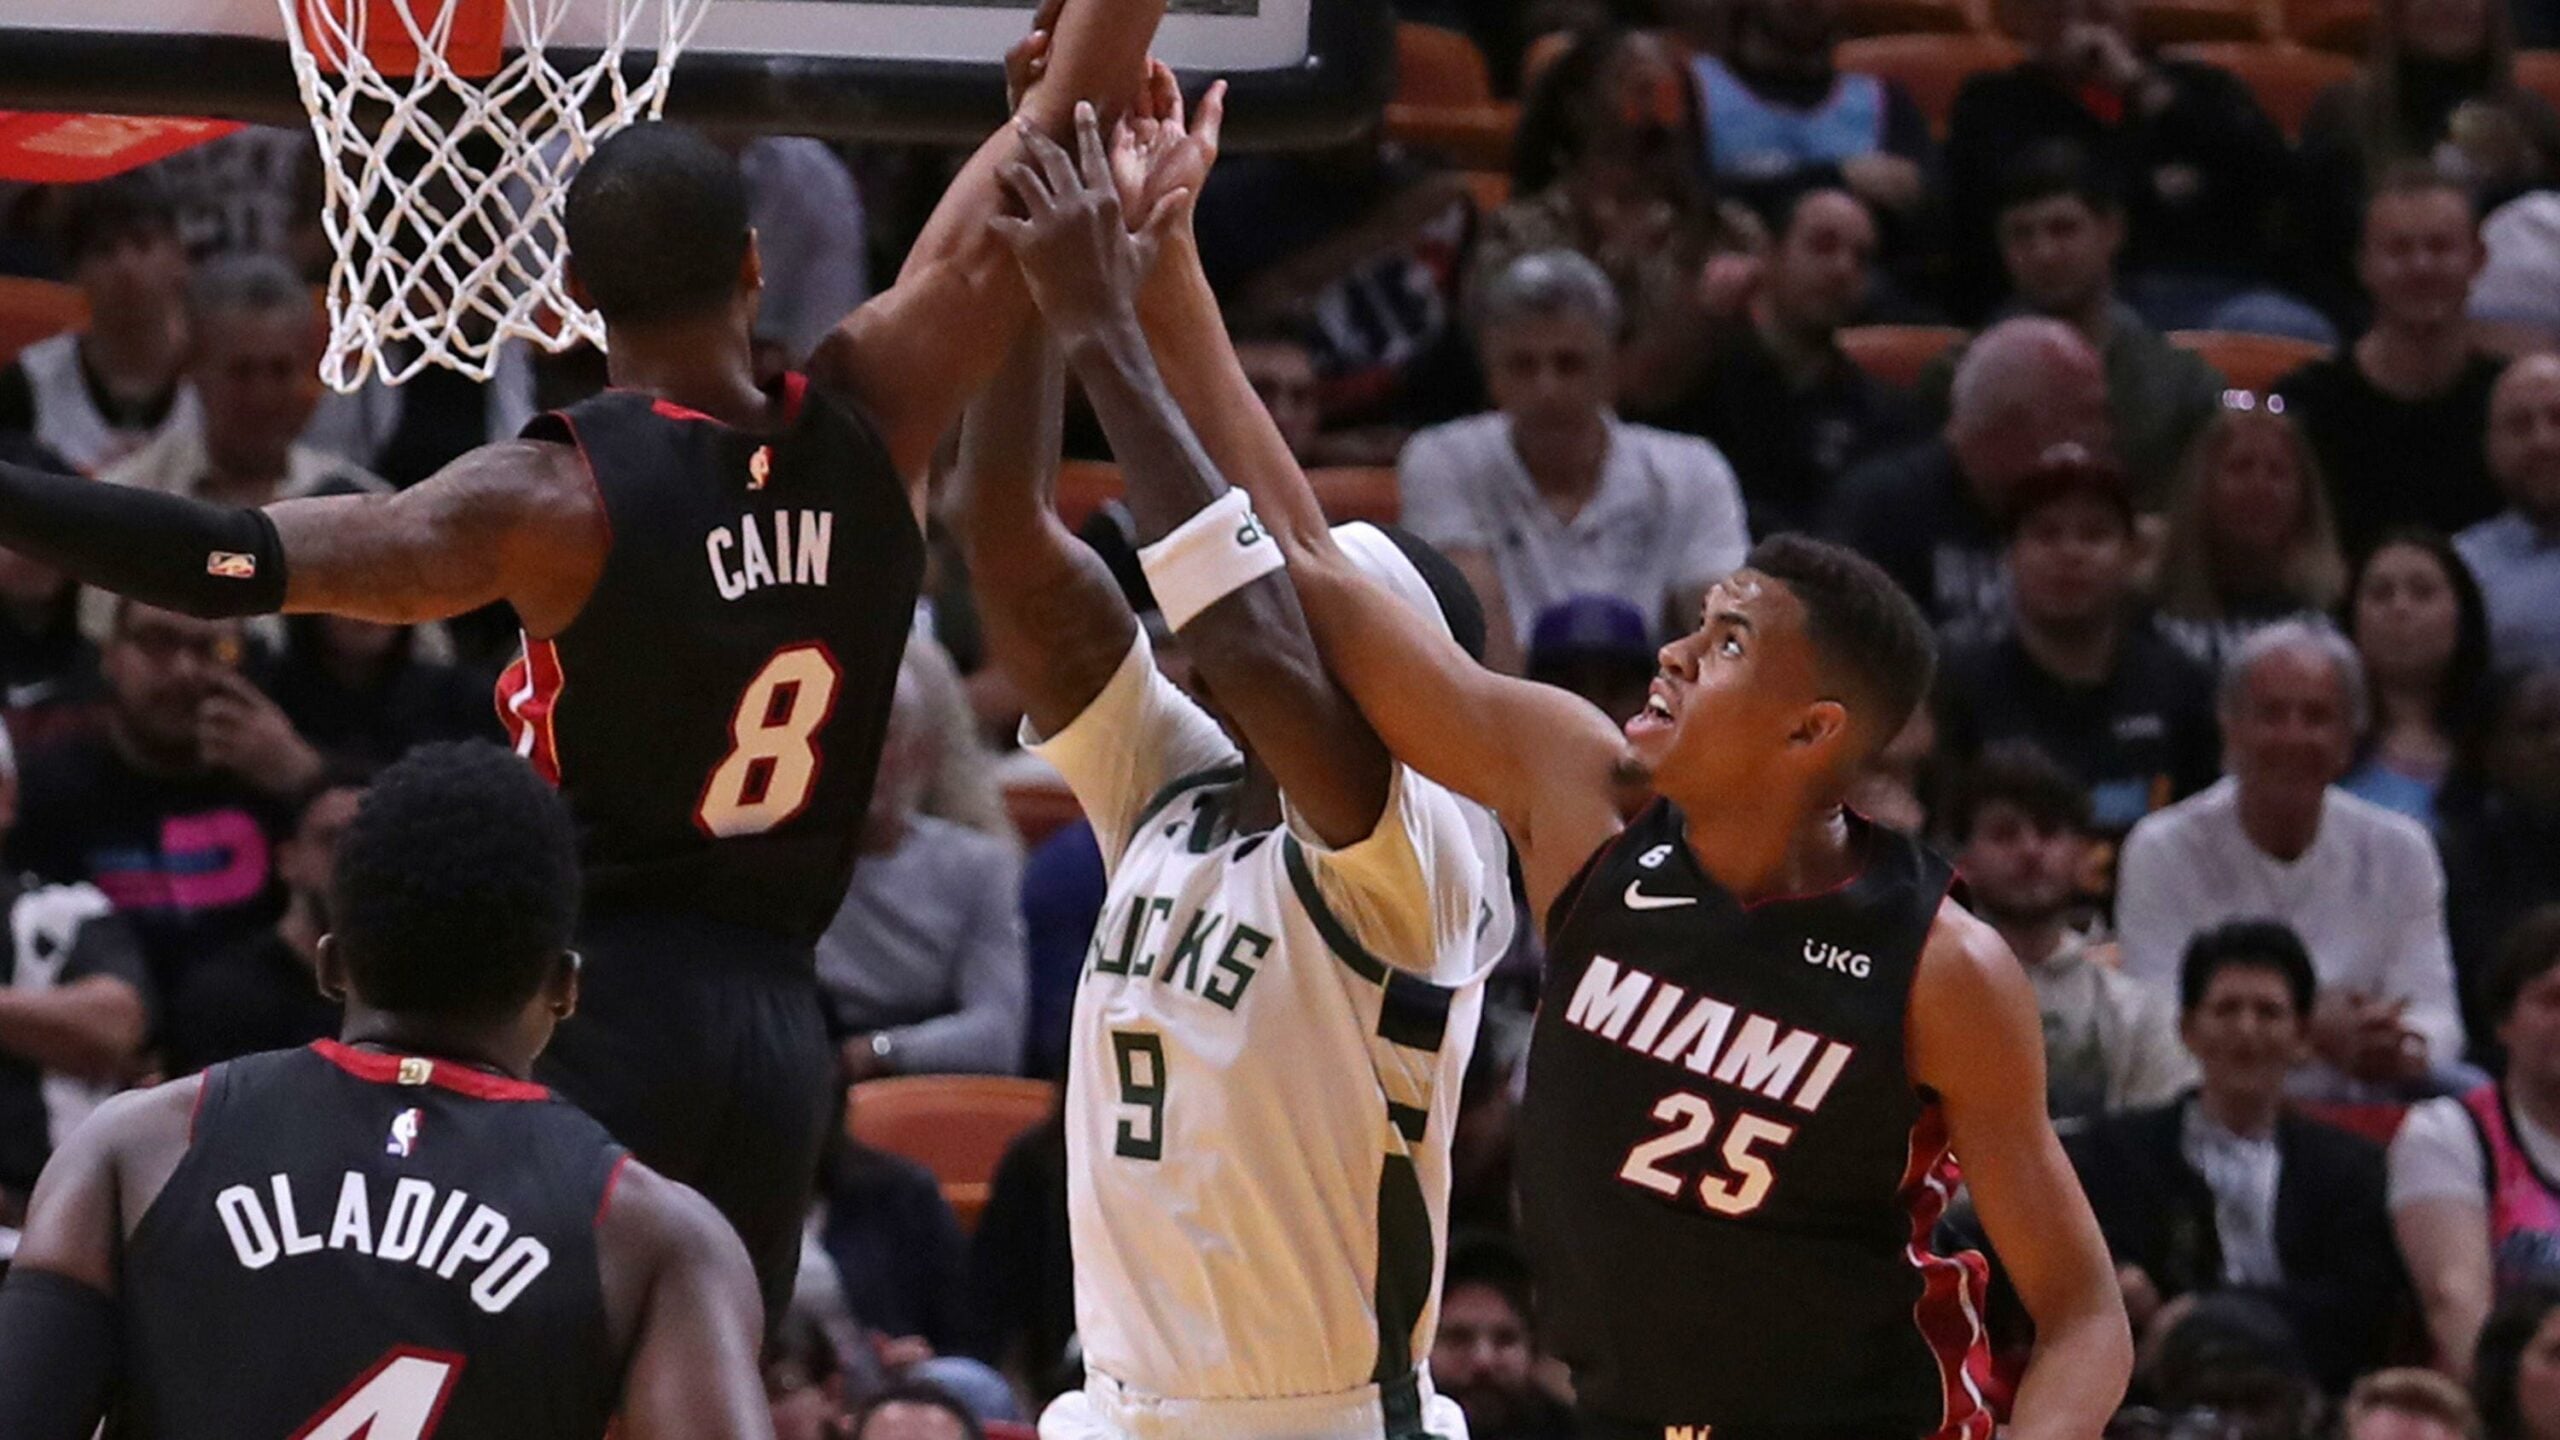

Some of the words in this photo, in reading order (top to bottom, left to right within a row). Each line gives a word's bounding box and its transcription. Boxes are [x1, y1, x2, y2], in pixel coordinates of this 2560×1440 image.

[706, 509, 833, 600] CAIN
[695, 642, 841, 839] 8
[1637, 844, 1674, 869] 6
[1084, 895, 1273, 1012] UCKS
[1111, 1030, 1166, 1162] 9
[1564, 953, 1854, 1113] MIAMI
[1617, 1089, 1795, 1219] 25
[215, 1170, 551, 1314] OLADIPO
